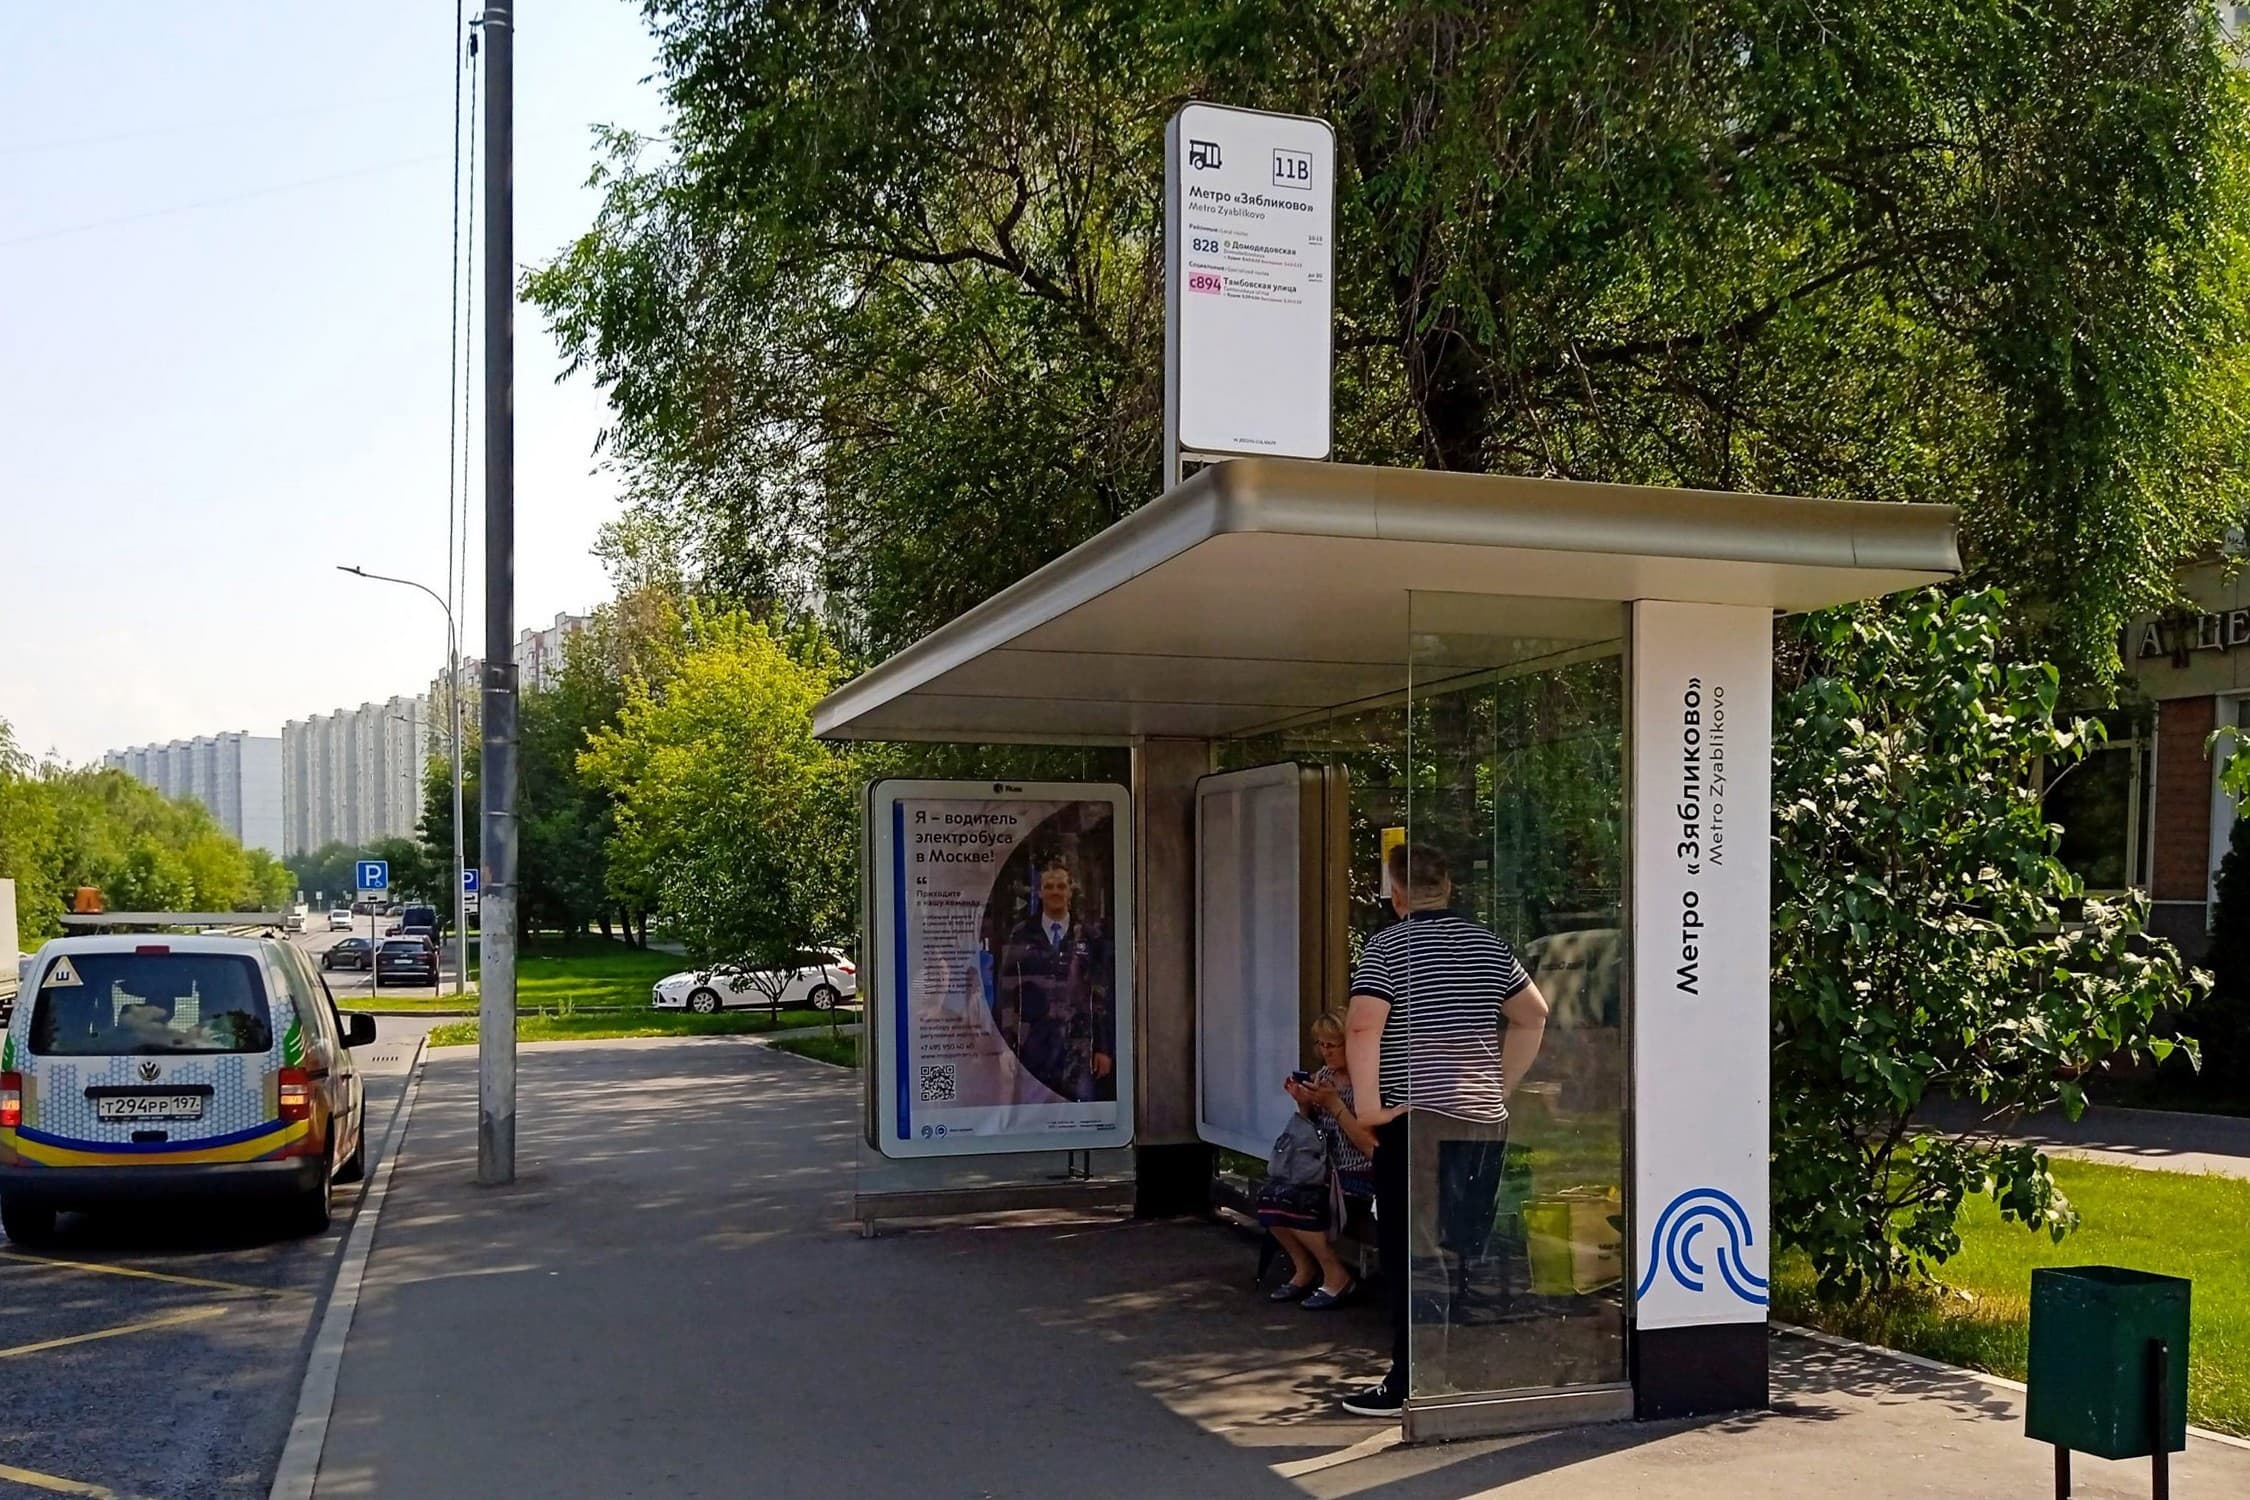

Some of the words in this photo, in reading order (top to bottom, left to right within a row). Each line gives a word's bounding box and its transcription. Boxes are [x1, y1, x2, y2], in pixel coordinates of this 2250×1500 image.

[1189, 185, 1231, 202] Метро
[1234, 193, 1314, 213] «Зябликово»
[1188, 202, 1216, 214] Metro
[1218, 205, 1266, 220] Zyablikovo
[1192, 238, 1219, 253] 828
[1232, 240, 1296, 256] Домодедовская
[1224, 277, 1272, 290] Тамбовская
[1273, 282, 1296, 293] улица
[1709, 686, 1726, 797] Zyablikovo
[1677, 677, 1702, 875] «Зябликово»
[915, 811, 926, 824] Я
[944, 814, 1018, 826] водитель
[916, 832, 1013, 847] электробуса
[1709, 803, 1724, 866] Metro
[916, 852, 925, 862] в
[928, 849, 995, 863] Москве!
[1676, 890, 1704, 996] Метро
[56, 971, 70, 981] Ш
[172, 1097, 197, 1108] 197
